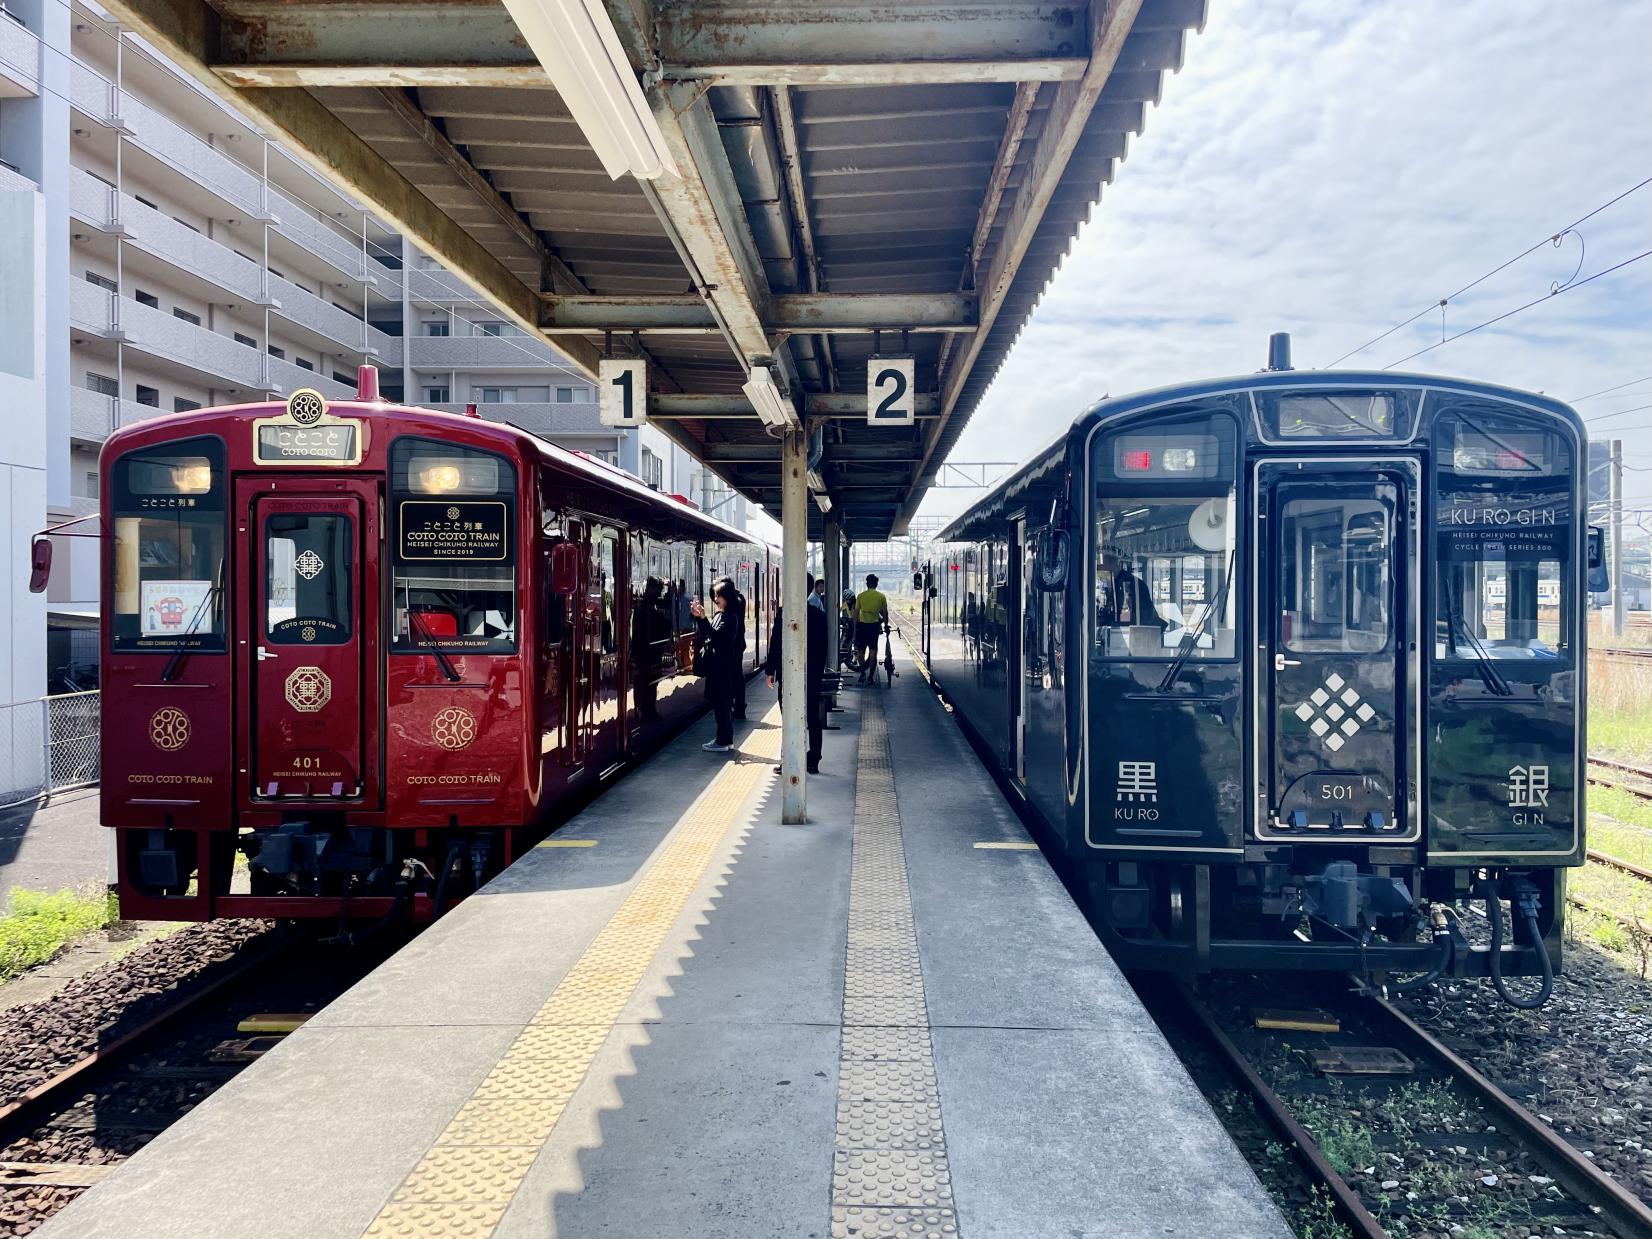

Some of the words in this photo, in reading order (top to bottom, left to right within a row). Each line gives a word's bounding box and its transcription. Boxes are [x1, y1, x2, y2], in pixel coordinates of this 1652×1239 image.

[612, 369, 633, 419] 1
[874, 368, 908, 419] 2
[279, 430, 340, 446] ことこと
[281, 448, 308, 456] COTO
[310, 448, 337, 456] COTO
[141, 498, 196, 507] ことこと列車
[424, 521, 483, 531] ことこと列車
[407, 532, 436, 541] COTO
[438, 532, 467, 541] COTO
[469, 532, 500, 541] TRAIN
[281, 621, 298, 630] COTO
[319, 620, 337, 630] TRAIN
[293, 757, 321, 768] 401
[128, 775, 154, 783] COTO
[156, 775, 182, 783] COTO
[184, 775, 212, 784] TRAIN
[407, 776, 436, 784] COTO
[438, 775, 467, 783] COTO
[470, 775, 501, 783] TRAIN
[1117, 761, 1157, 802] 黒
[1508, 765, 1549, 807] 銀
[1321, 784, 1352, 800] 501
